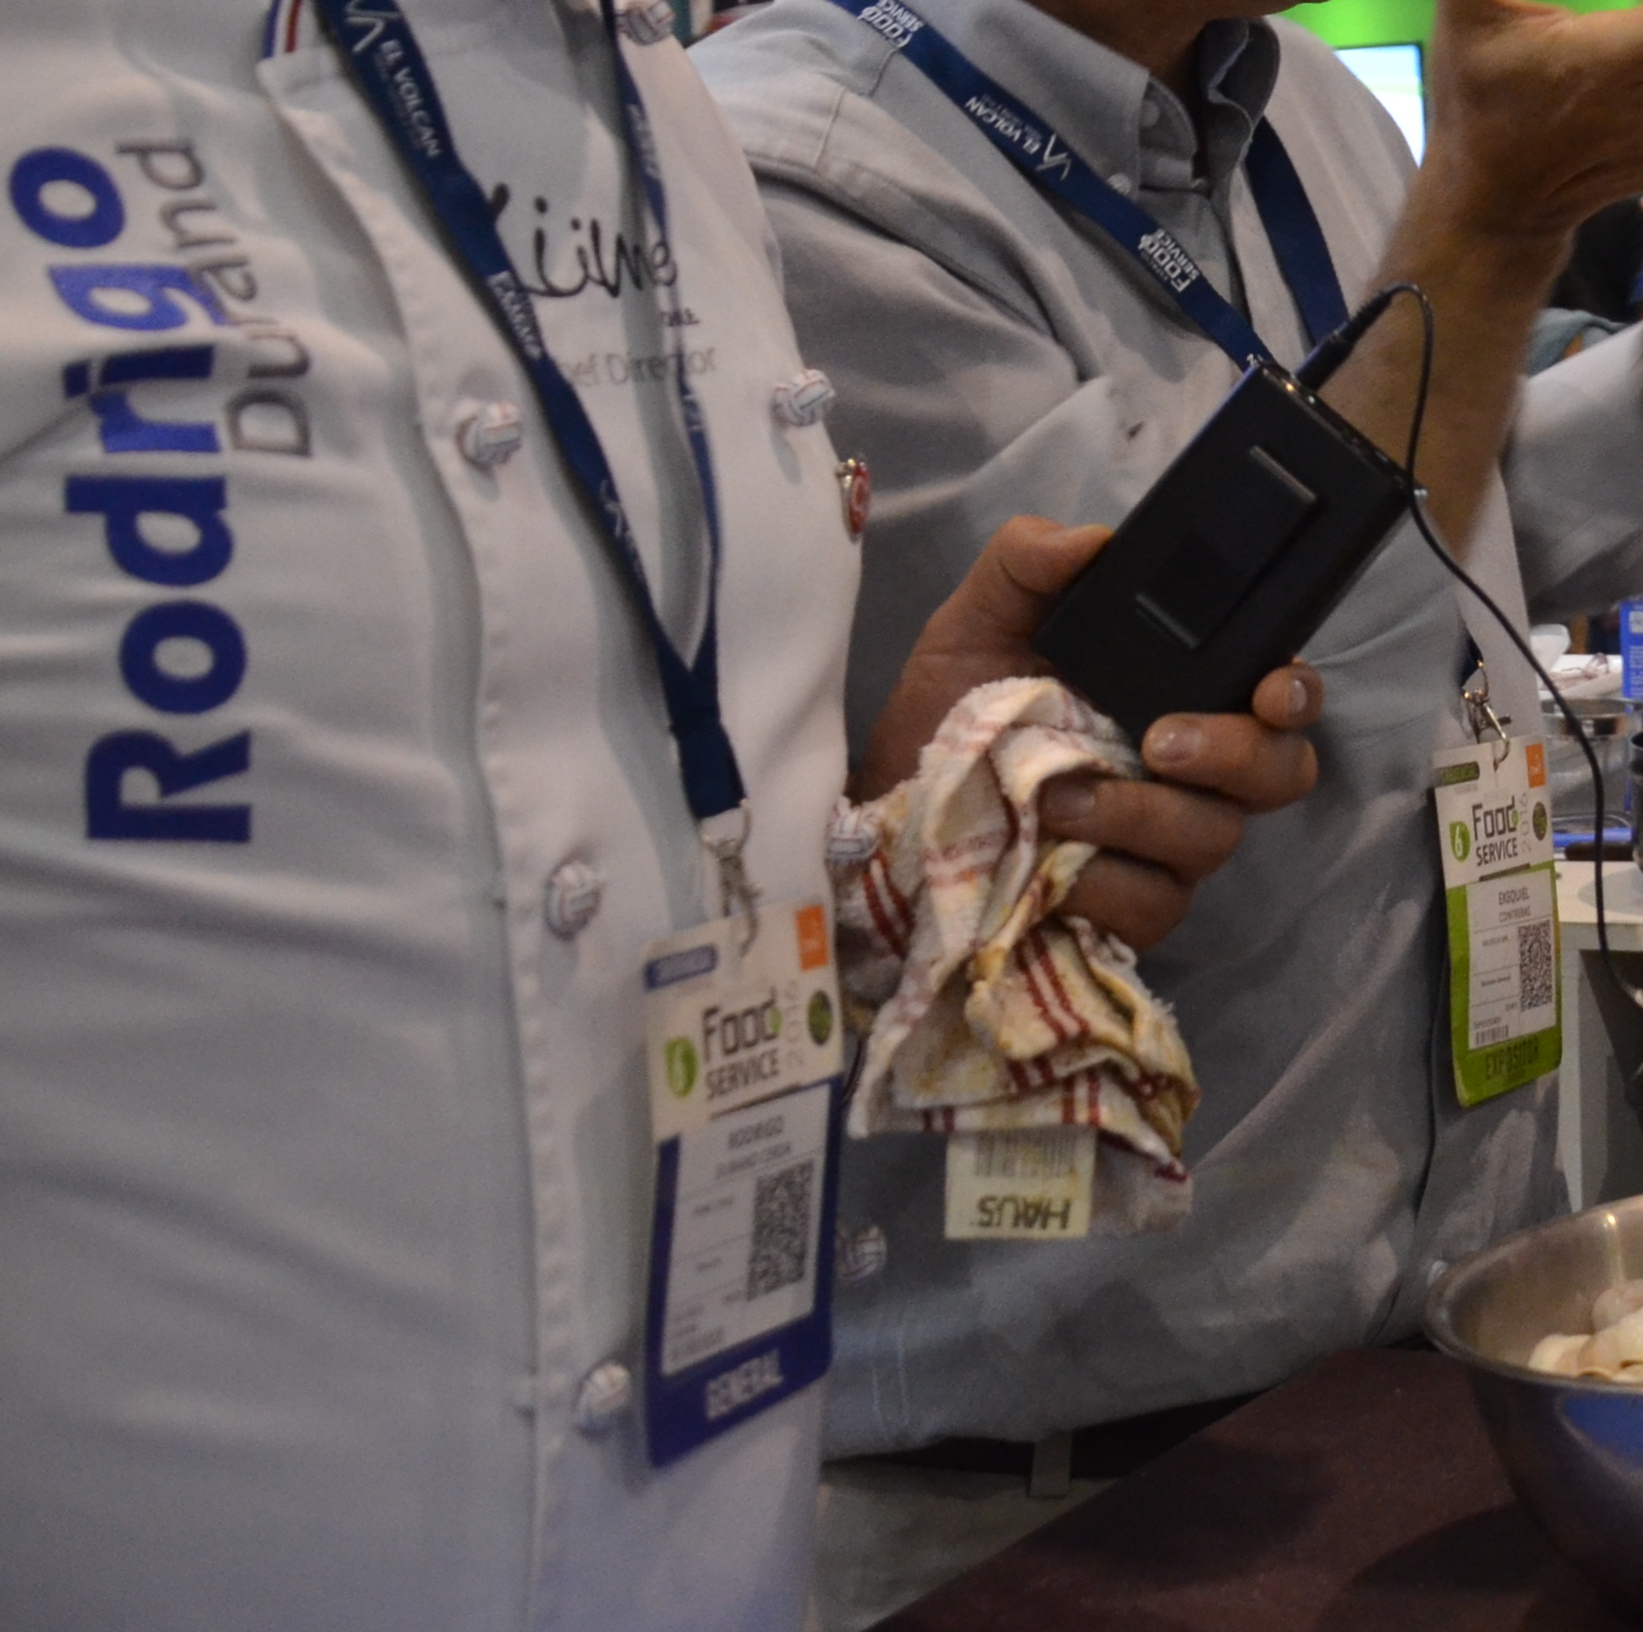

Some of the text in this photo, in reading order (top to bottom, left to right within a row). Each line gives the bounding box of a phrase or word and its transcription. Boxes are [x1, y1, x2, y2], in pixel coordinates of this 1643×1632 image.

[964, 95, 1022, 143] VOLCAN
[115, 138, 312, 459] Durand
[9, 146, 253, 844] Rodrigo
[1475, 836, 1519, 867] SERVICE
[974, 1194, 1071, 1231] HAUS
